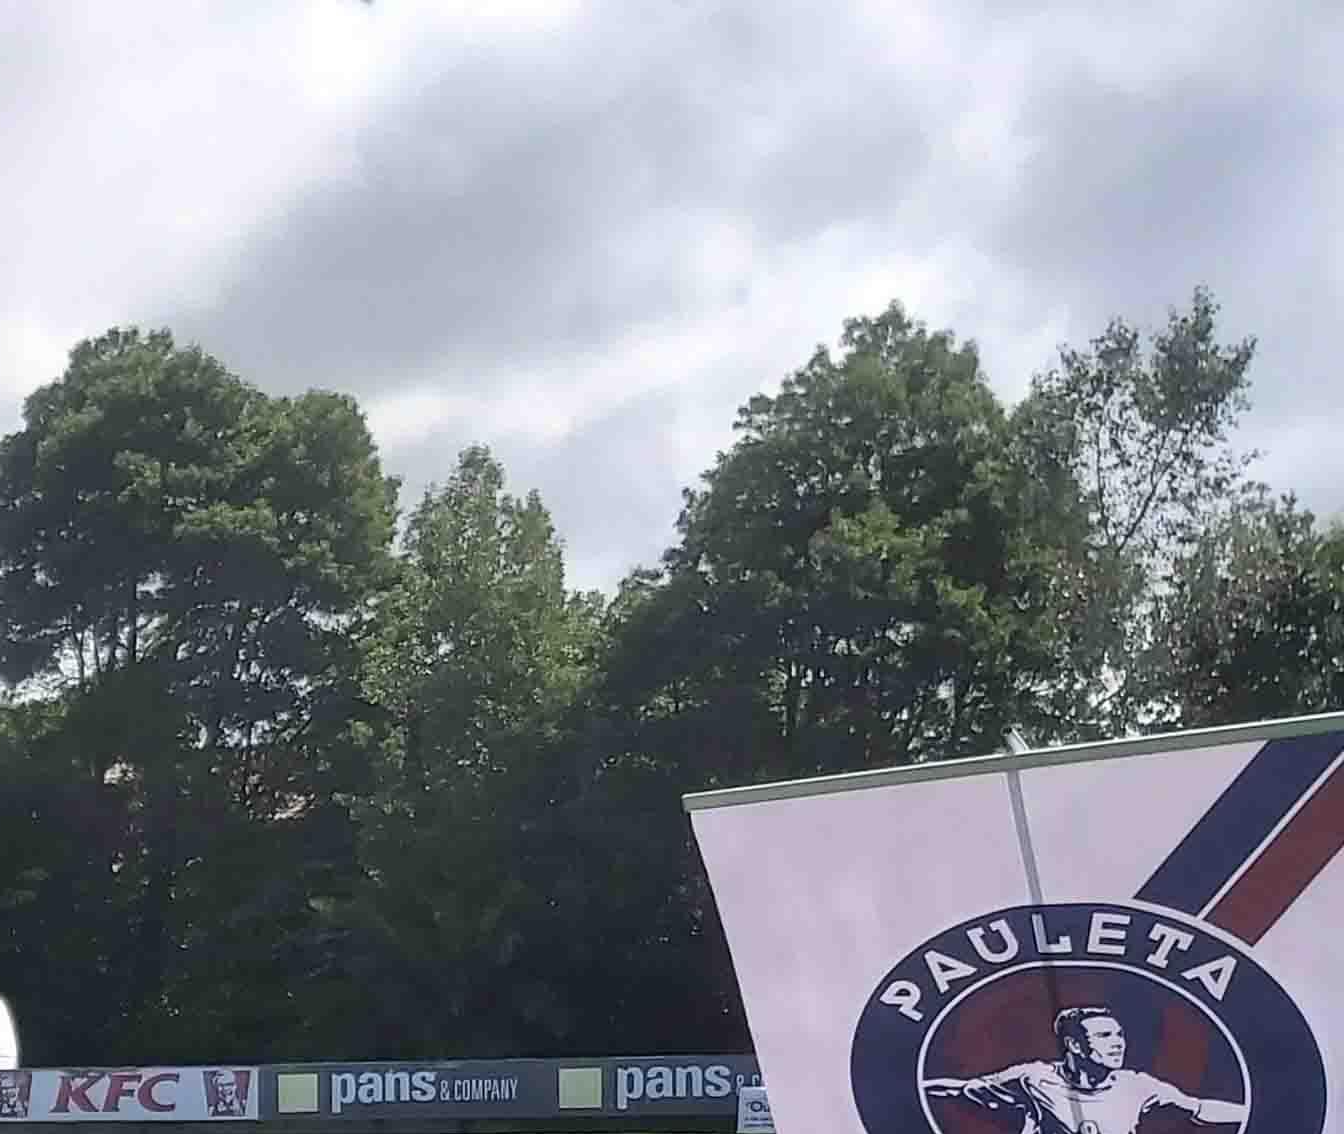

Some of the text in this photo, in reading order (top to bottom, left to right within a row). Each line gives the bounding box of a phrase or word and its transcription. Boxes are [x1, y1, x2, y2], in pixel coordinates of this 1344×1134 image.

[879, 911, 1239, 1023] PAULETA
[48, 1071, 180, 1114] KFC
[331, 1071, 518, 1113] pans & COMPANY
[617, 1065, 731, 1109] pans
